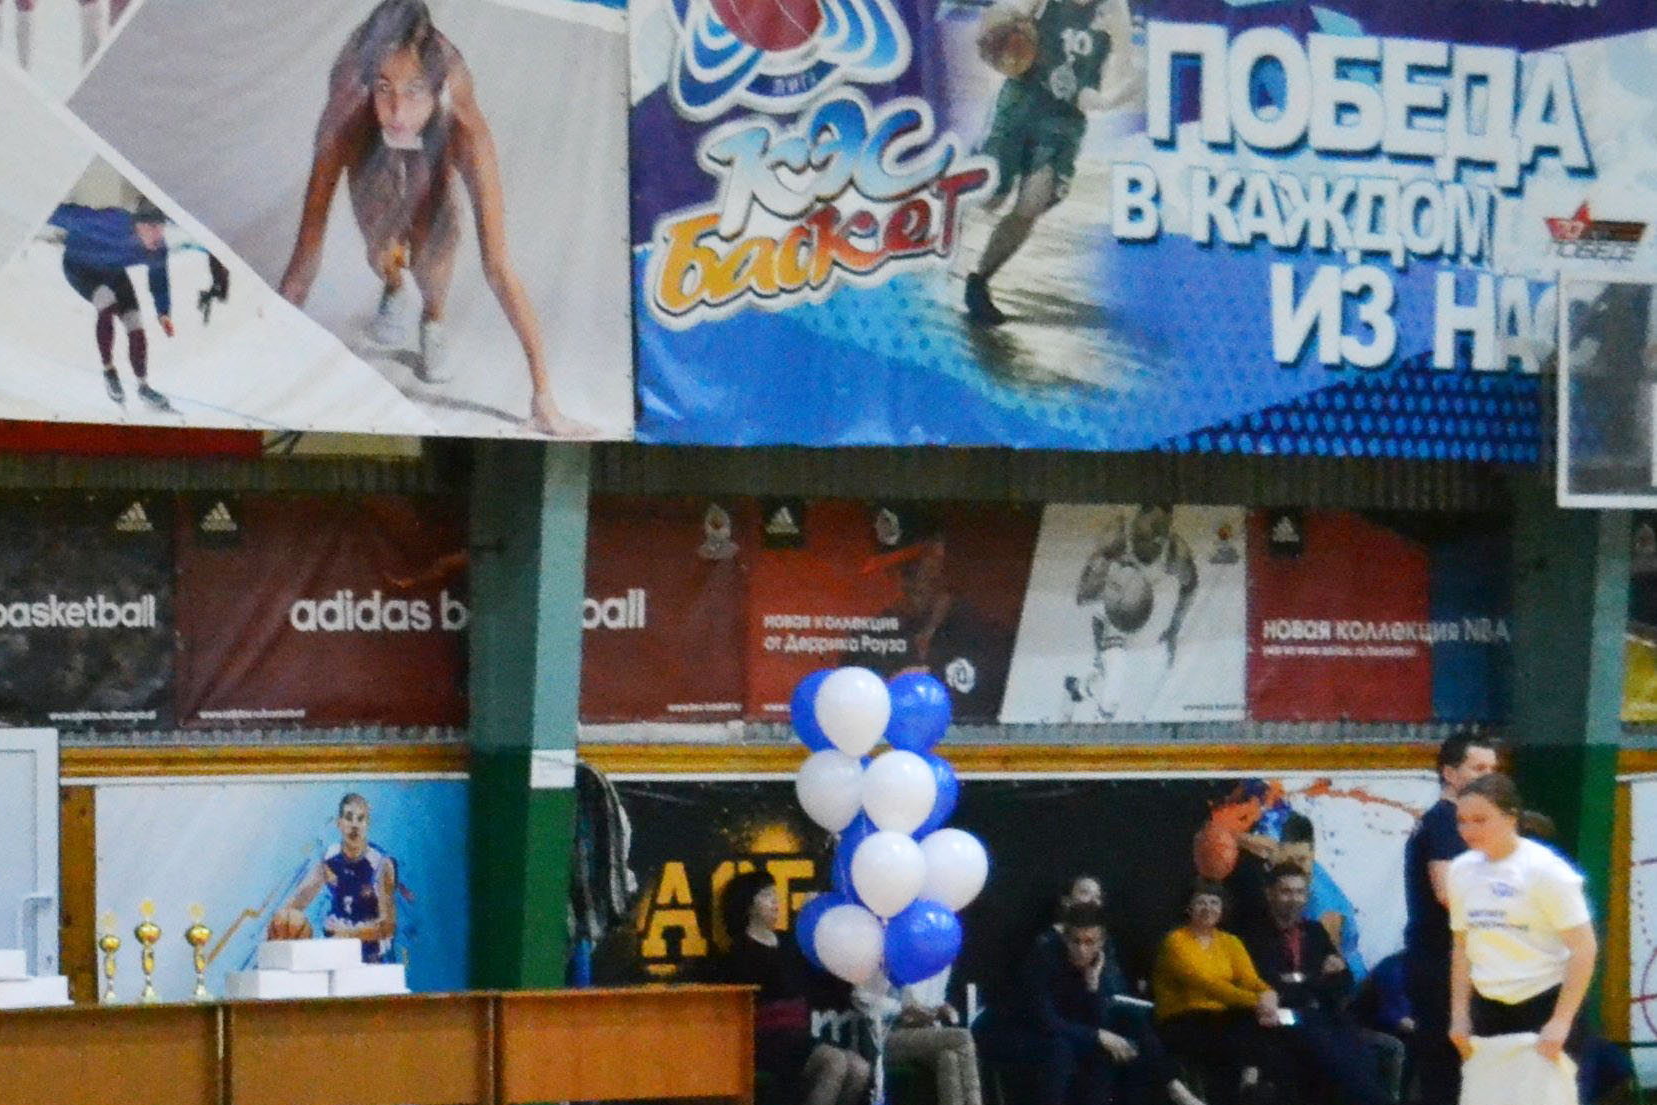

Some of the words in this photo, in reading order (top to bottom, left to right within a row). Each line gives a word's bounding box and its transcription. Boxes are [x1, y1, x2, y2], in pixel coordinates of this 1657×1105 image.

[1145, 20, 1597, 190] ПОБЕДА
[1112, 161, 1160, 244] В
[1190, 165, 1498, 270] КАЖДОМ
[1269, 260, 1398, 370] ИЗ
[291, 589, 431, 631] adidas
